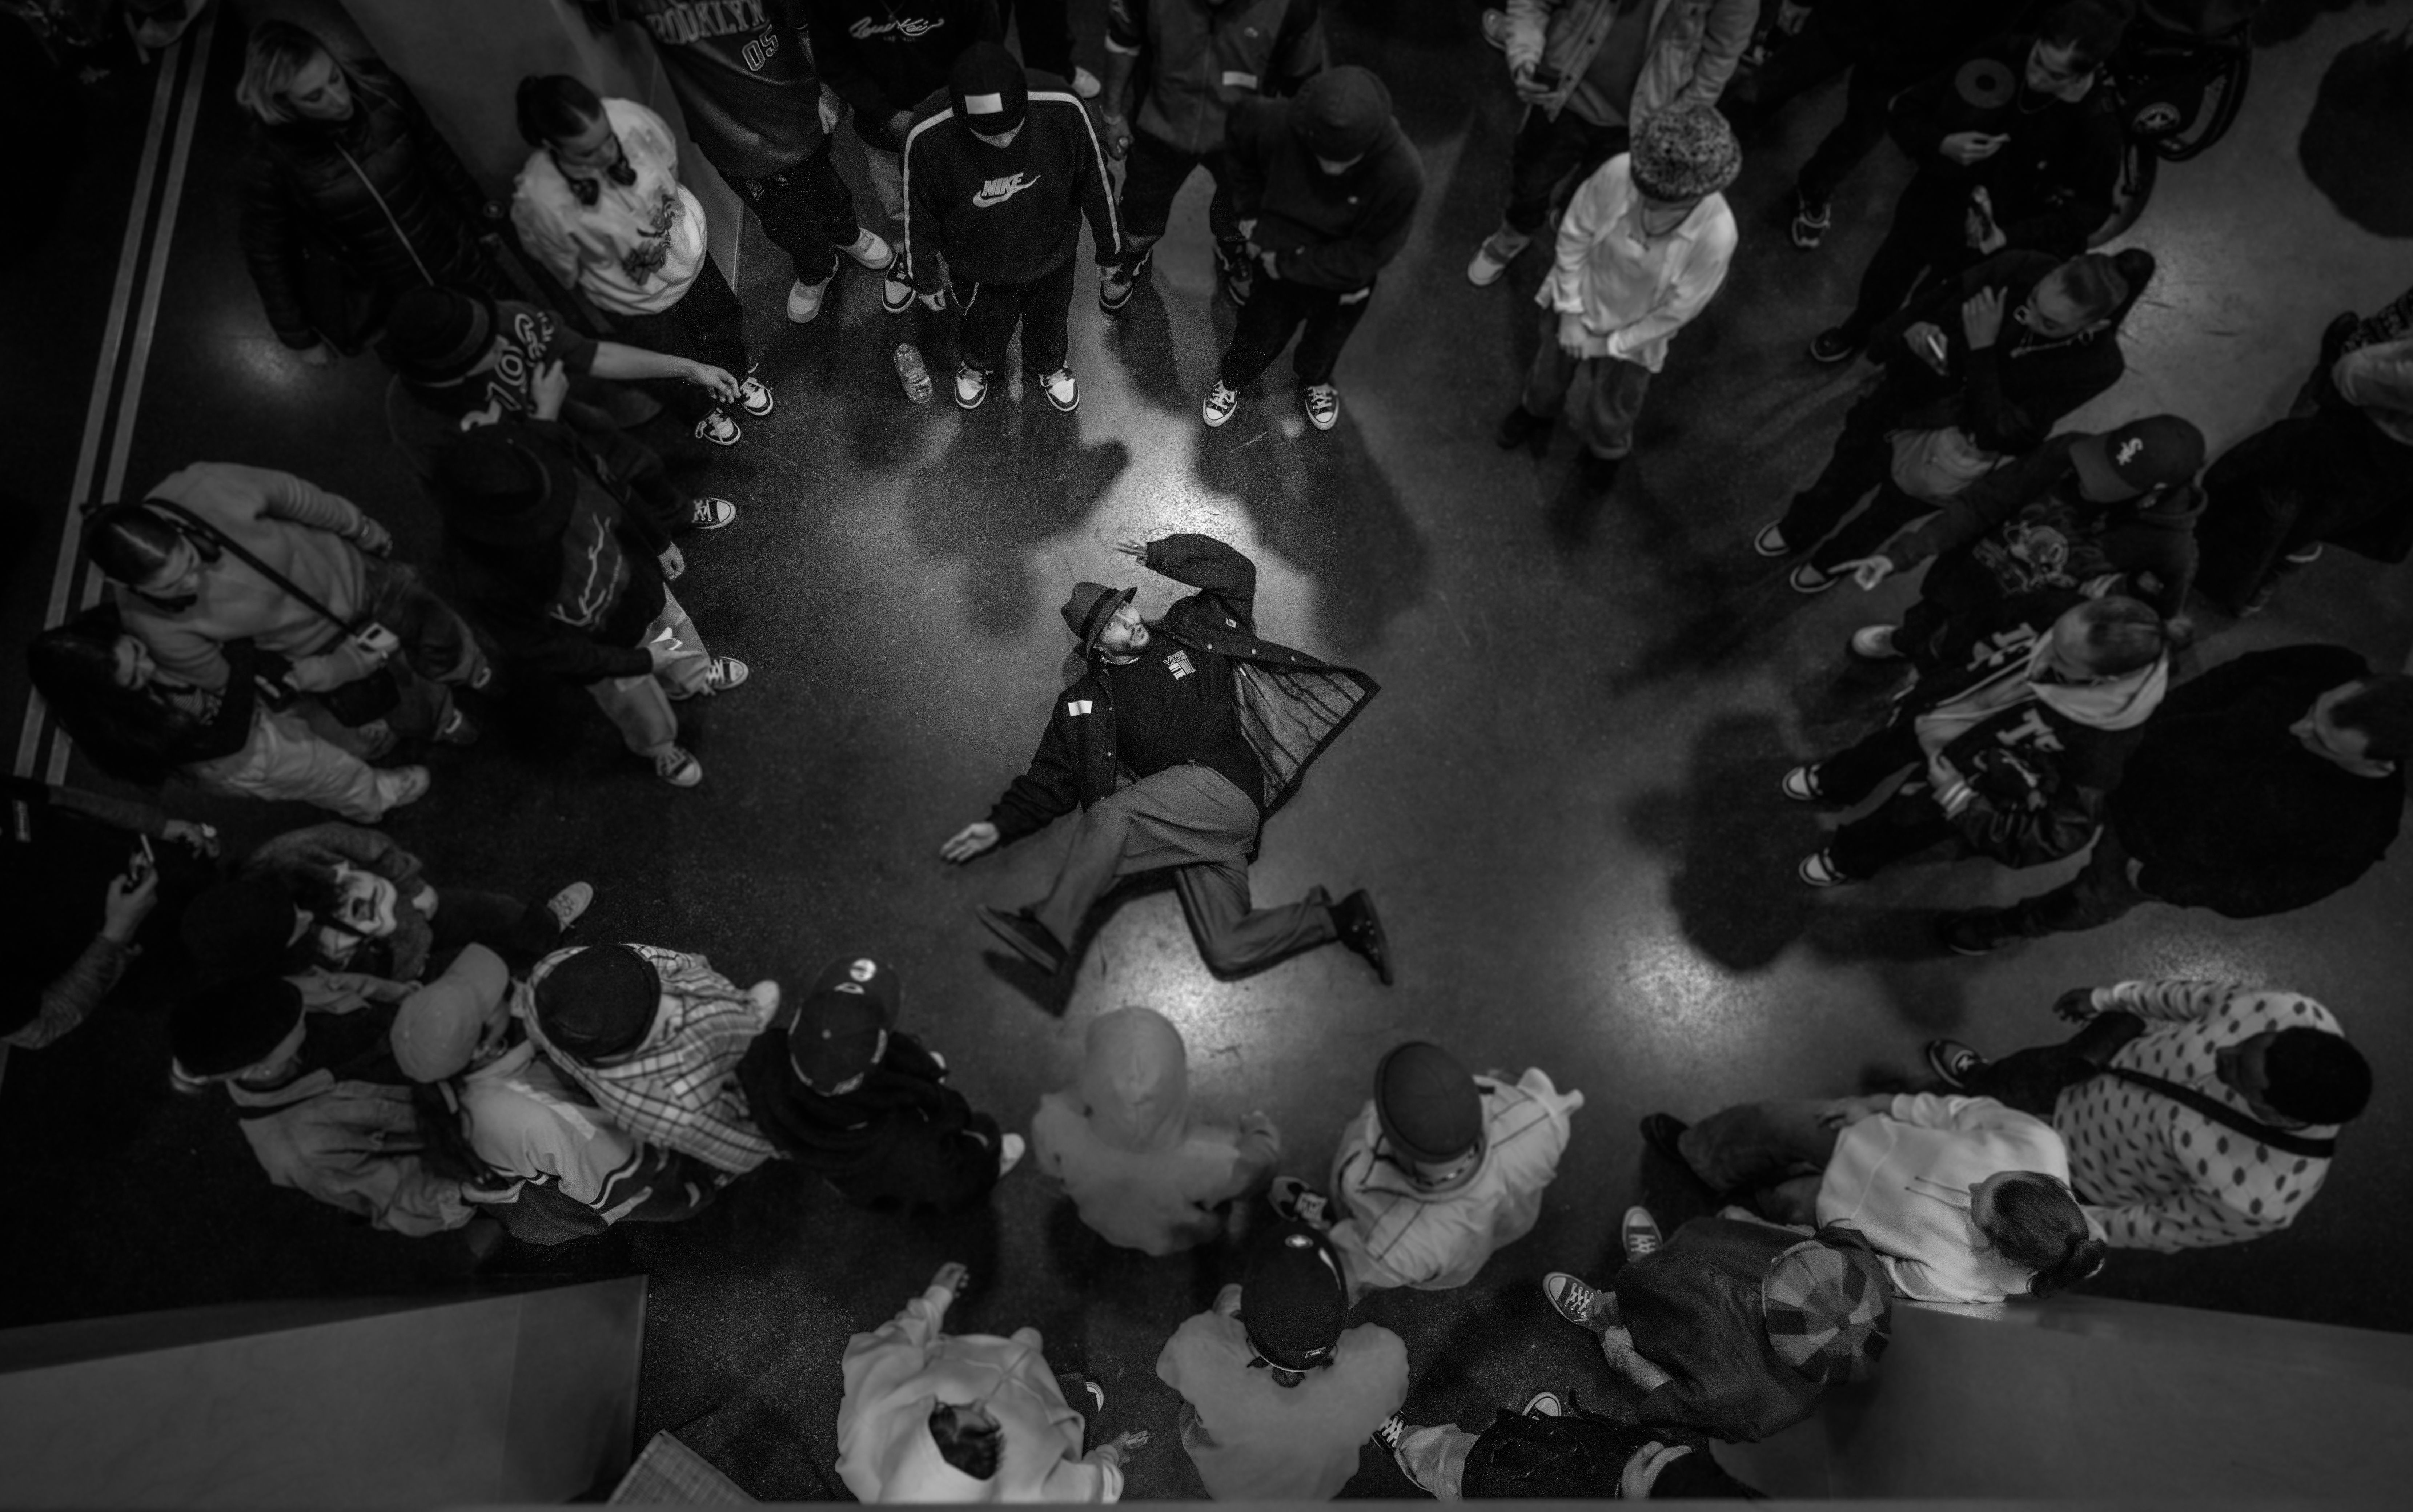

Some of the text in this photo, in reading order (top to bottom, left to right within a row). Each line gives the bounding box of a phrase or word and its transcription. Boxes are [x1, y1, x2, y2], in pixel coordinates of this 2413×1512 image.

[742, 24, 779, 72] 05
[981, 172, 1024, 197] NIKE
[1163, 650, 1187, 666] VANS
